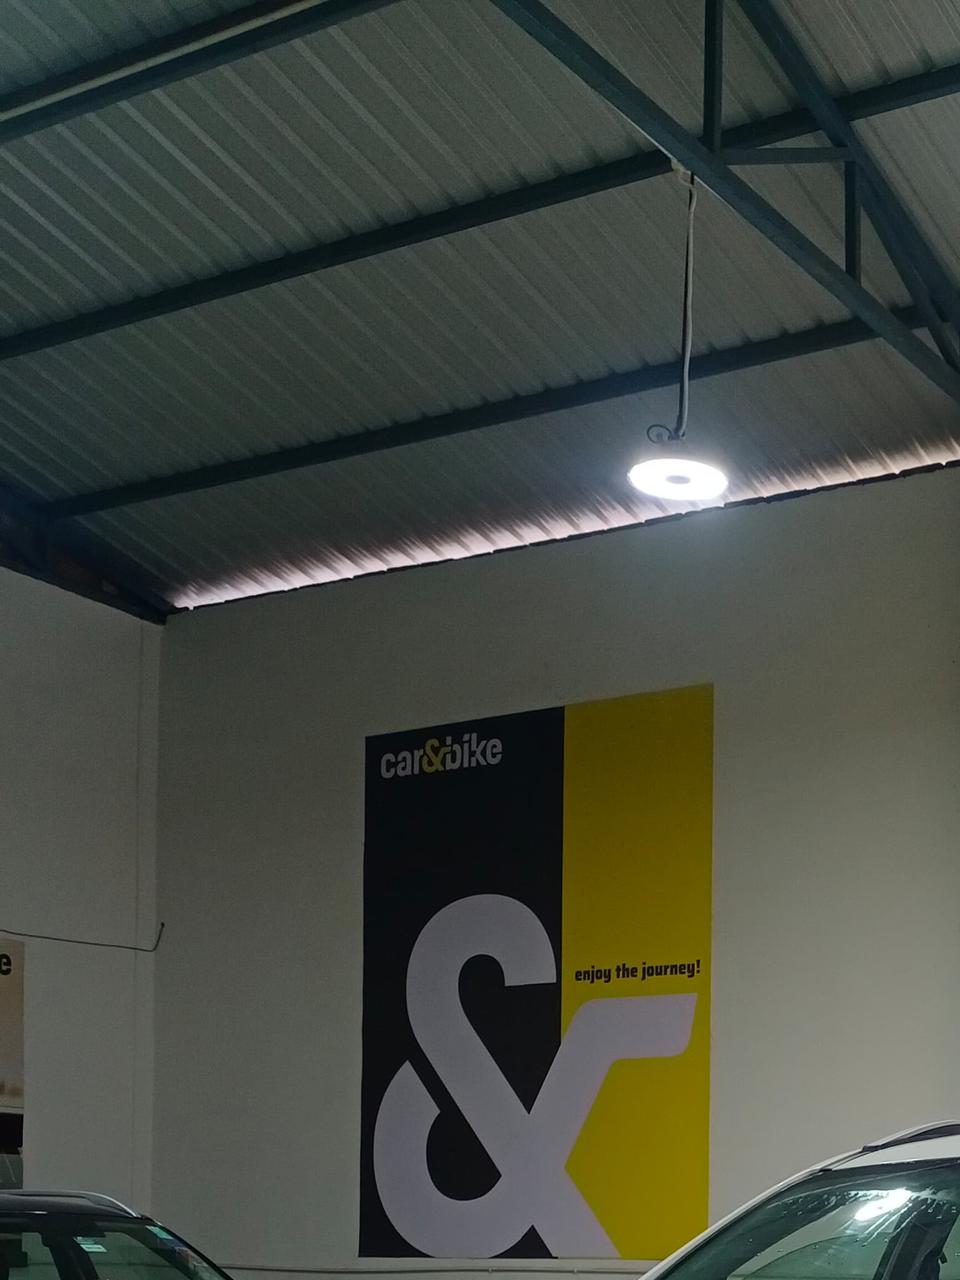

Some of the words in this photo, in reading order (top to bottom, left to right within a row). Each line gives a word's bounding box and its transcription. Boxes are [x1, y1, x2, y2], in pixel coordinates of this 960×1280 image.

[380, 732, 503, 779] car&bike
[574, 965, 612, 984] enjoy
[616, 962, 638, 979] the
[641, 959, 701, 981] journey!
